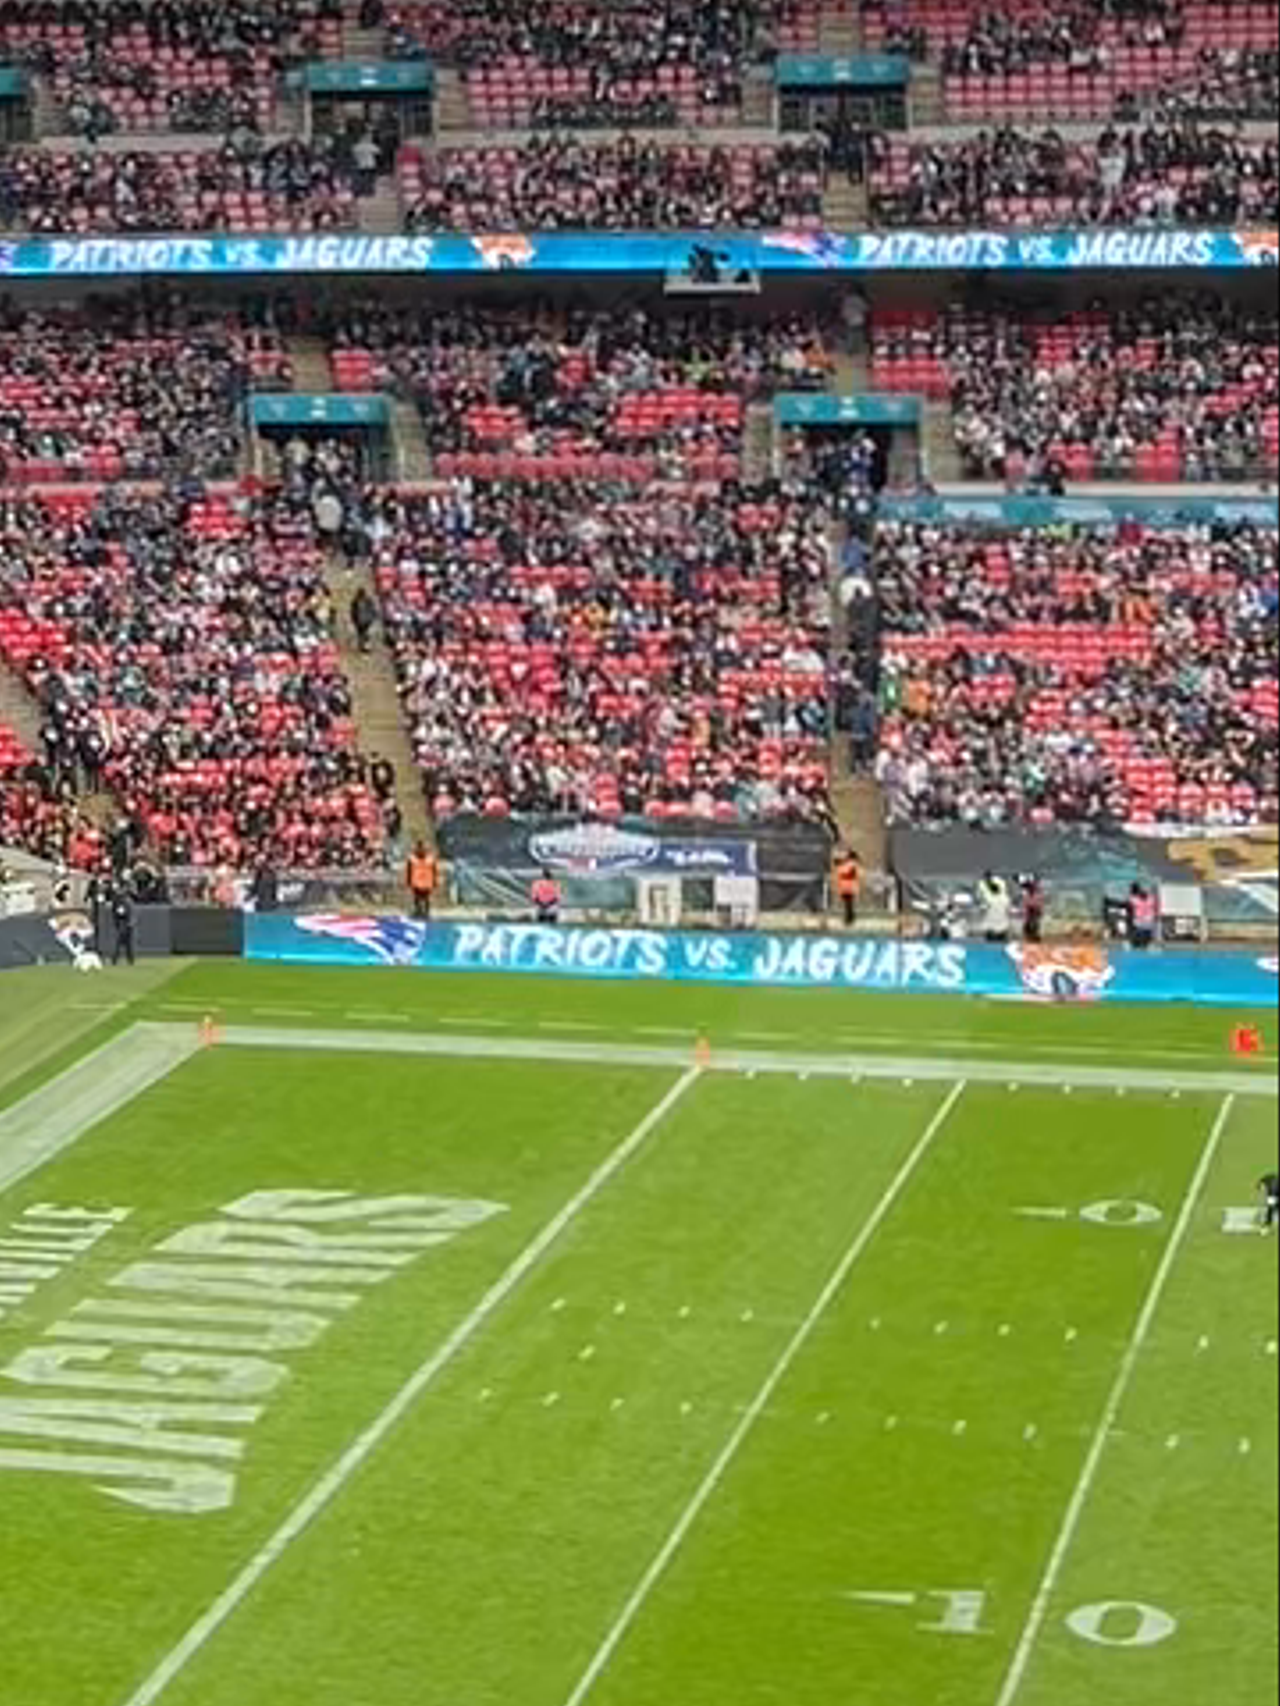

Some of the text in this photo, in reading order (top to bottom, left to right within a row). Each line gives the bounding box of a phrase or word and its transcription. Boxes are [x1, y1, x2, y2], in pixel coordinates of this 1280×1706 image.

[48, 239, 213, 270] PATRIOTS
[275, 236, 432, 269] JAGUARS
[858, 235, 1008, 265] PATRIOTS
[1068, 234, 1214, 265] JAGUARS
[452, 924, 667, 974] PATRIOTS
[755, 938, 966, 985] JAGUARS
